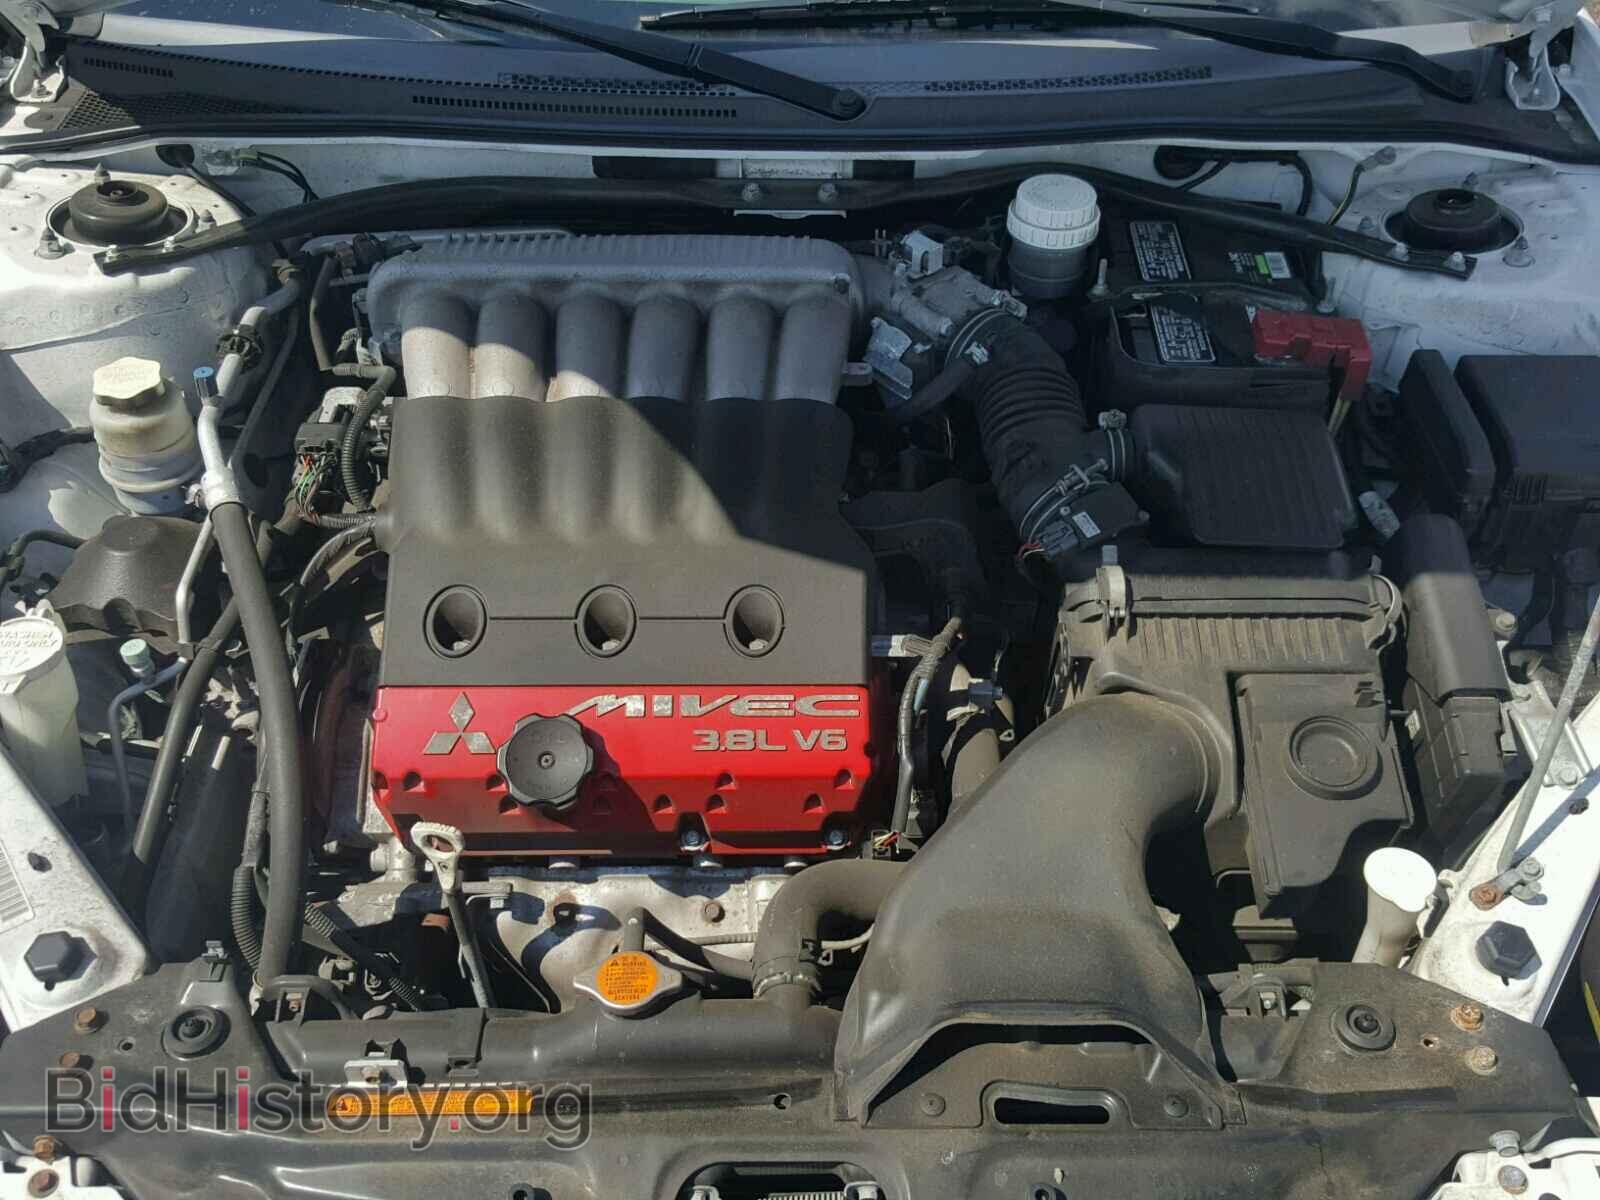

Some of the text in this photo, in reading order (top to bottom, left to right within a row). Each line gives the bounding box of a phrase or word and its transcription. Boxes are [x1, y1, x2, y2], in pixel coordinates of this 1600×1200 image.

[567, 694, 860, 717] MIVEC
[692, 728, 848, 751] 3.8L V6
